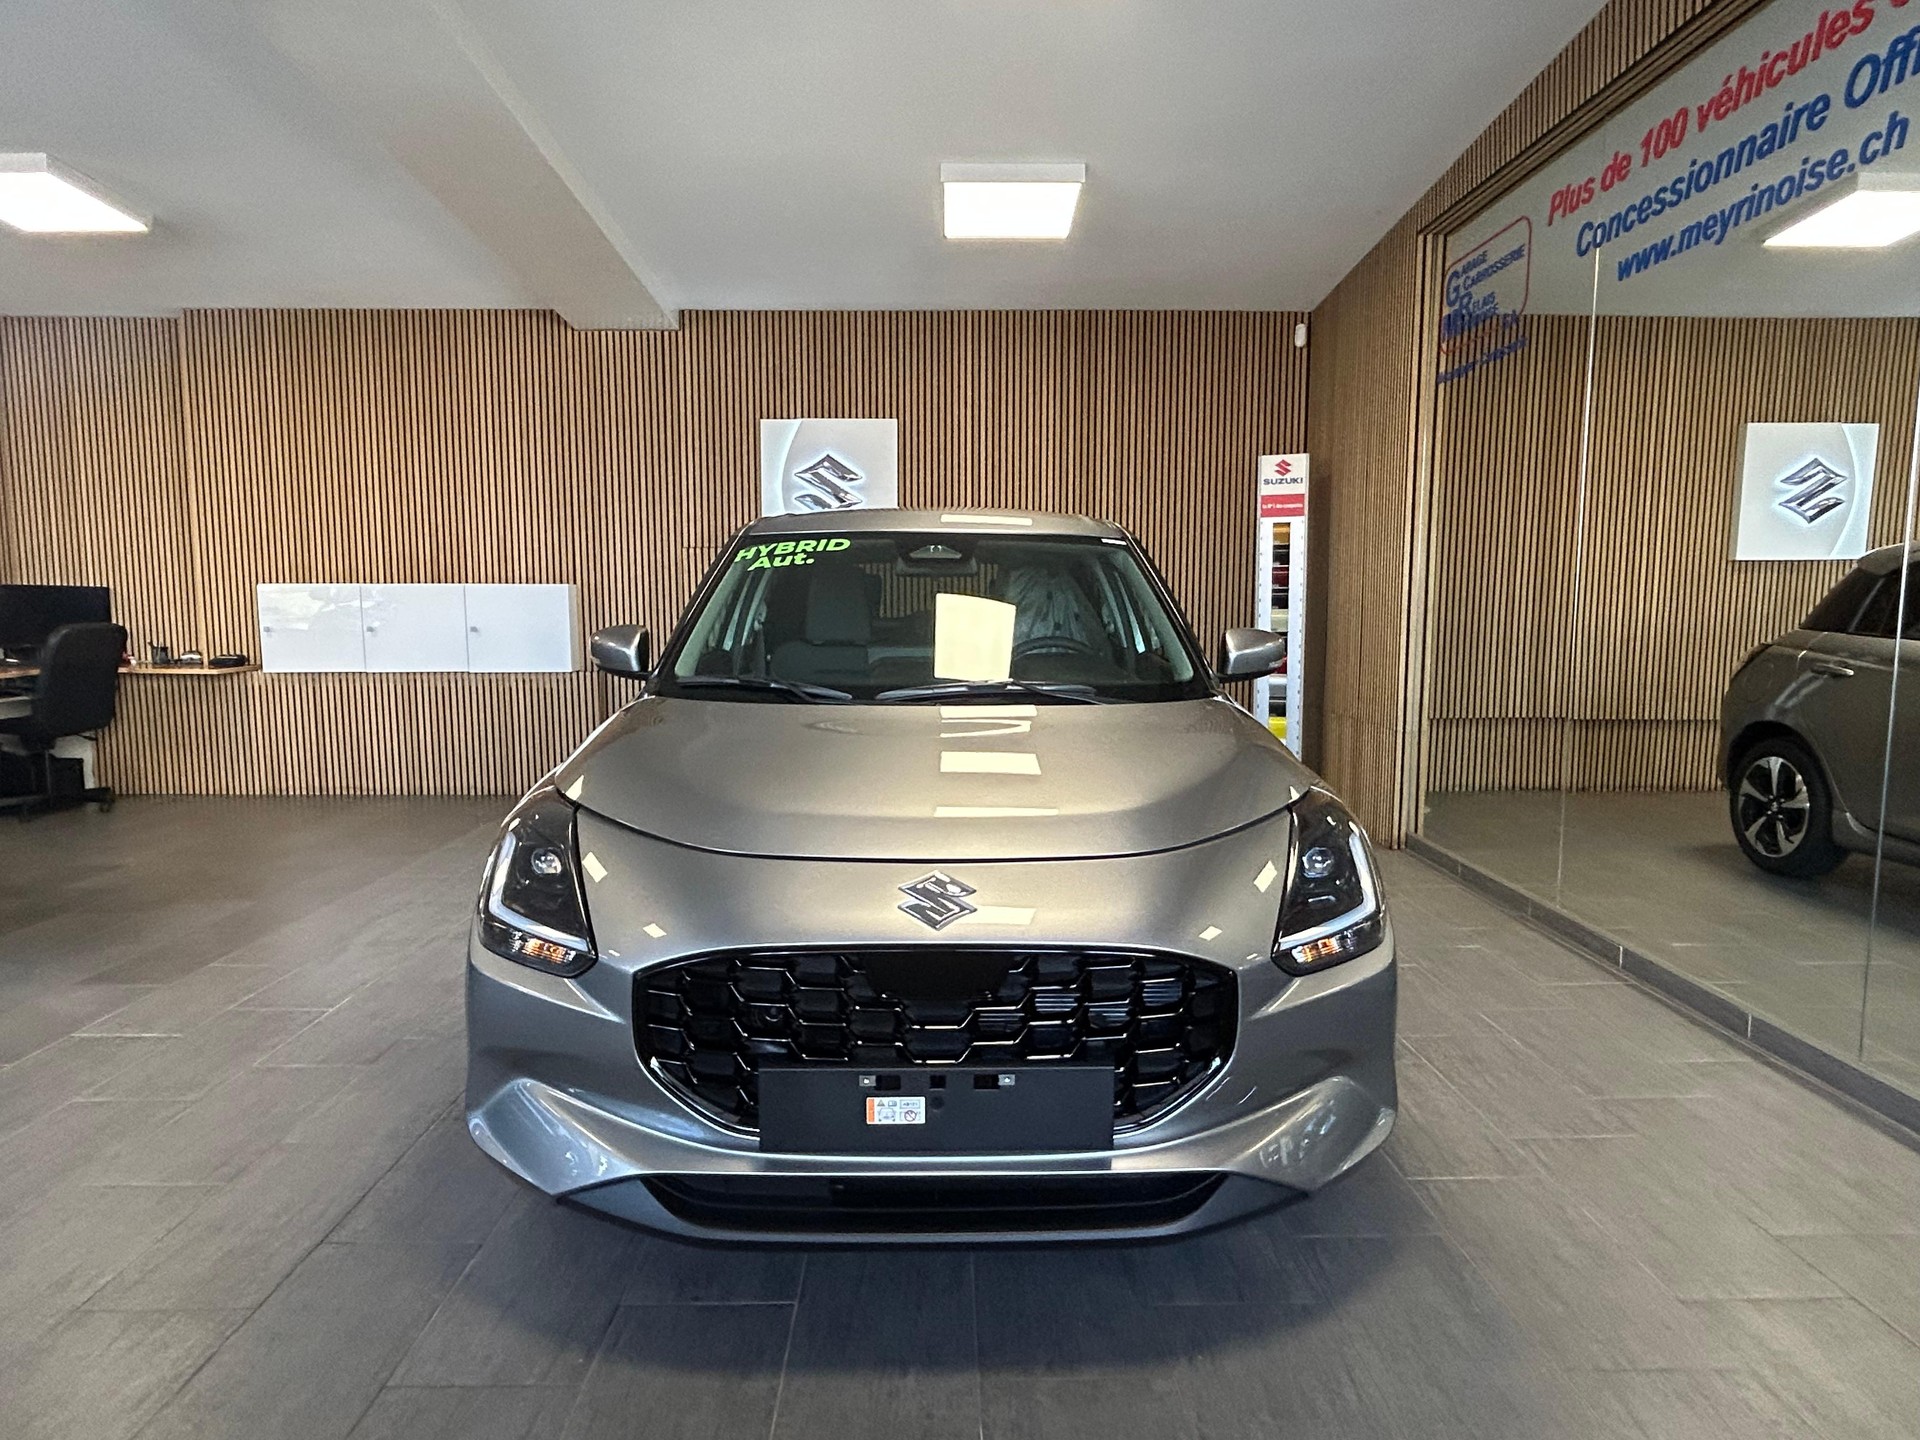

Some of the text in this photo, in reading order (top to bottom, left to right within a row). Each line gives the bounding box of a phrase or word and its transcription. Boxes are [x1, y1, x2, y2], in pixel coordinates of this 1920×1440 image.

[1549, 0, 1875, 226] Plus de 100 véhicules
[1576, 93, 1831, 257] Concessionnaire
[1617, 110, 1910, 281] www.meyrinoise.ch
[1263, 477, 1304, 486] SUZUKI
[734, 538, 851, 563] HYBRID
[747, 552, 815, 572] Aut.
